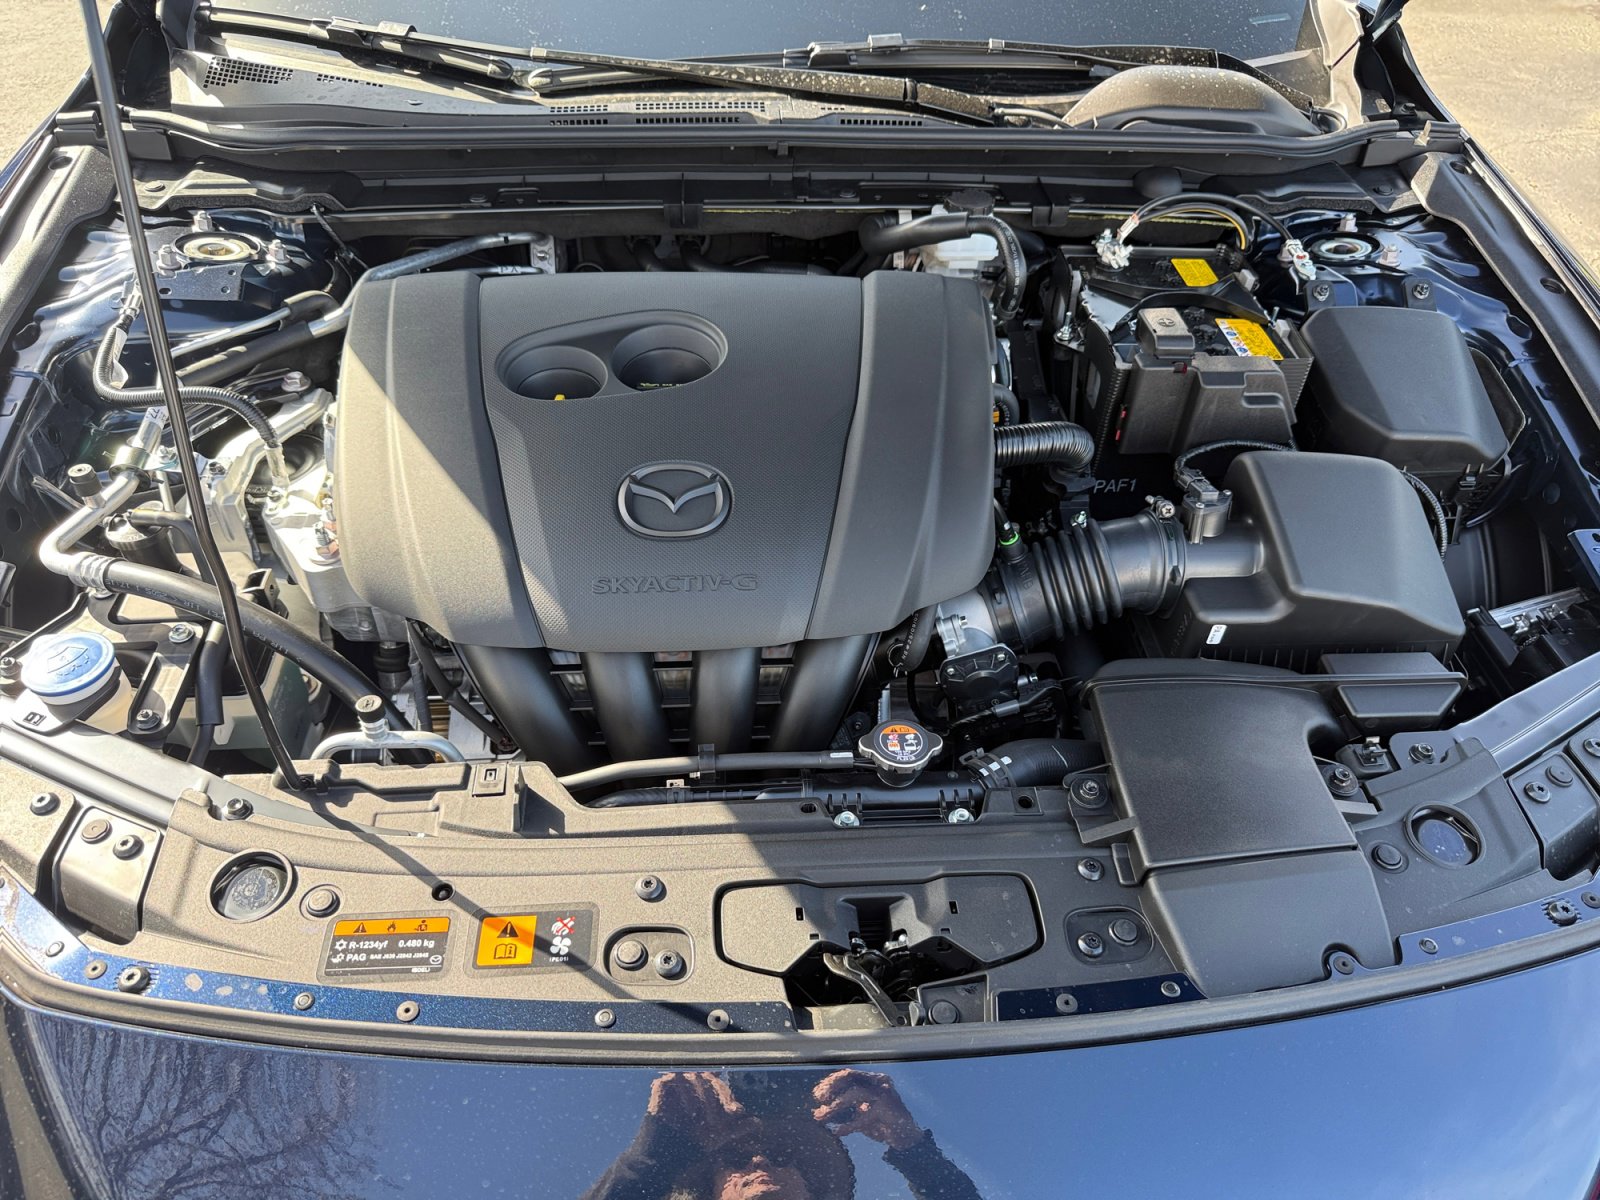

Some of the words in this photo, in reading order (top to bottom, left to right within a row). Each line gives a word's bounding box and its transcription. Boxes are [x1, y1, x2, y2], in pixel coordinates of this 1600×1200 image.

[1093, 478, 1137, 494] PAF1
[592, 573, 758, 595] SKYACTIV-G
[348, 940, 389, 950] R-1234yf
[398, 939, 421, 948] 0.480
[423, 938, 435, 949] kg
[346, 953, 367, 962] PAG
